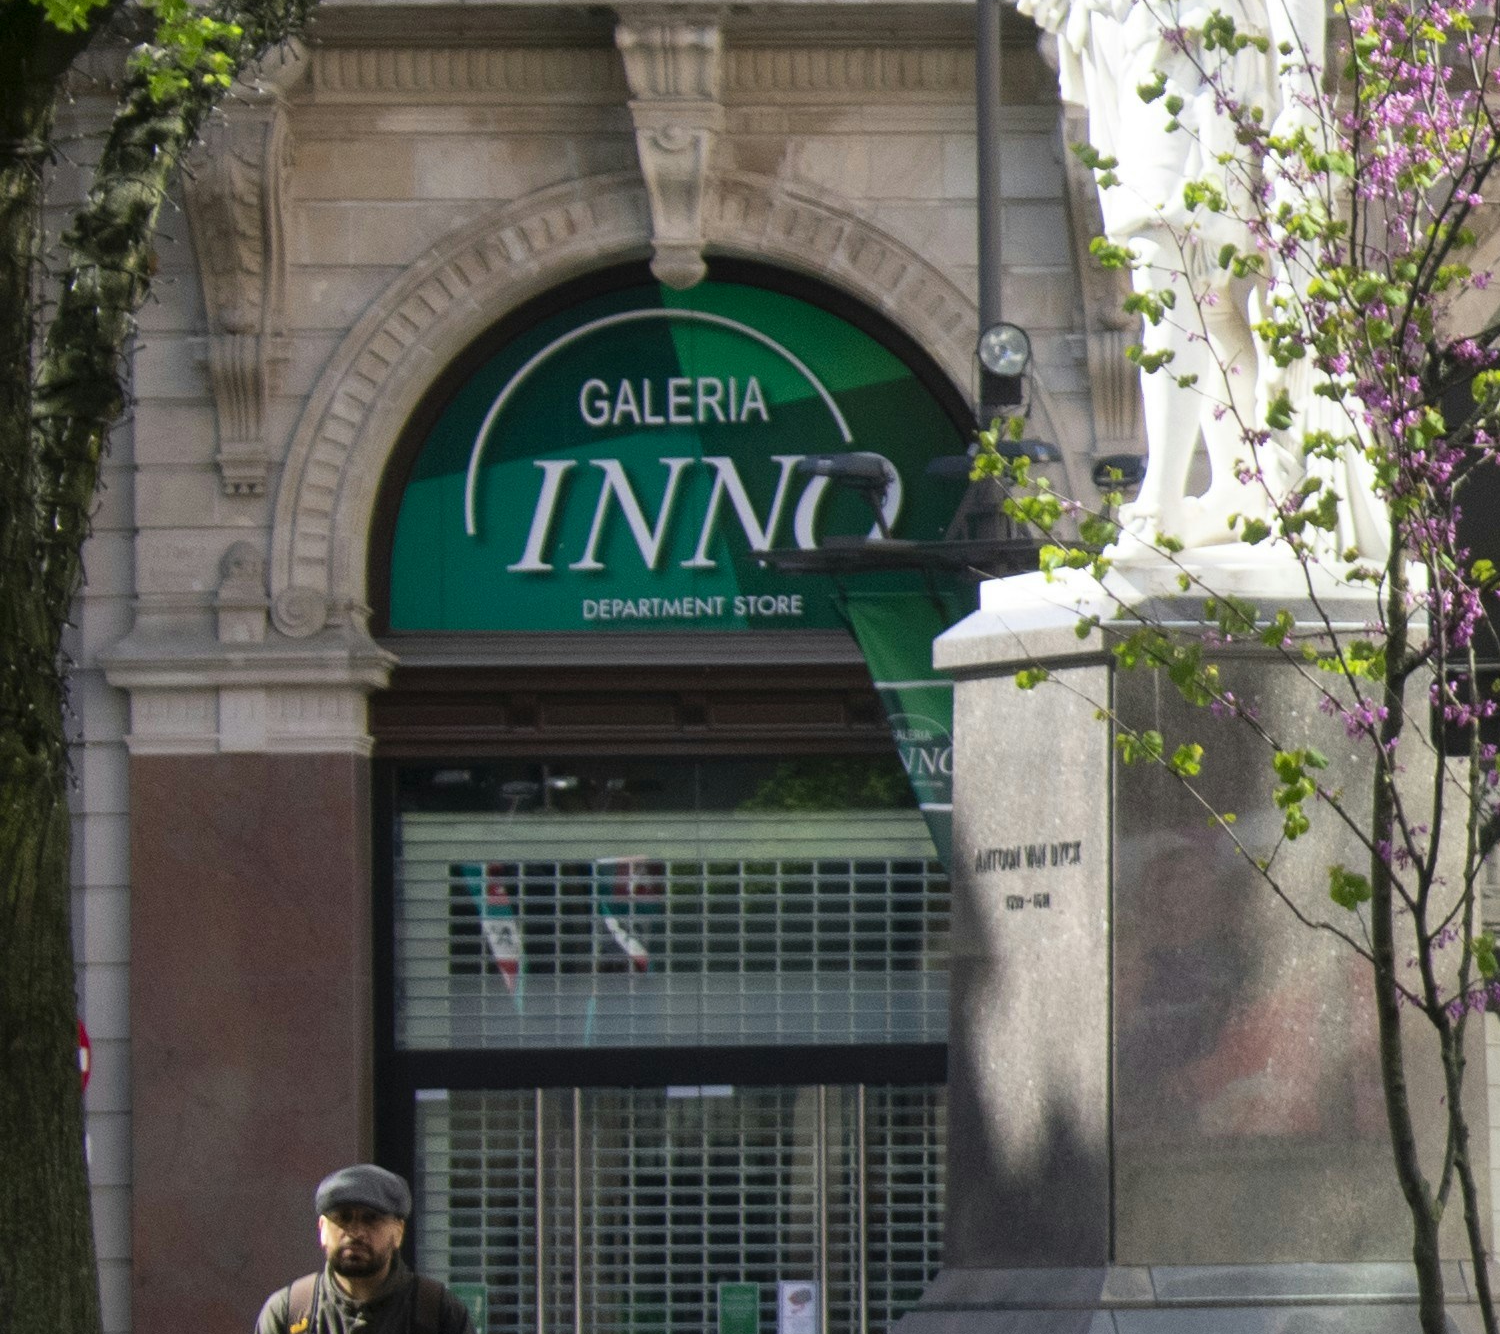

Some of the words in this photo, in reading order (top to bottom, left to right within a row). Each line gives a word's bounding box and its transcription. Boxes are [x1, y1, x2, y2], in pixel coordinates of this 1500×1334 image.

[579, 377, 769, 427] GALERIA
[505, 451, 902, 574] INNO
[582, 596, 726, 621] DEPARTMENT
[732, 593, 803, 618] STORE
